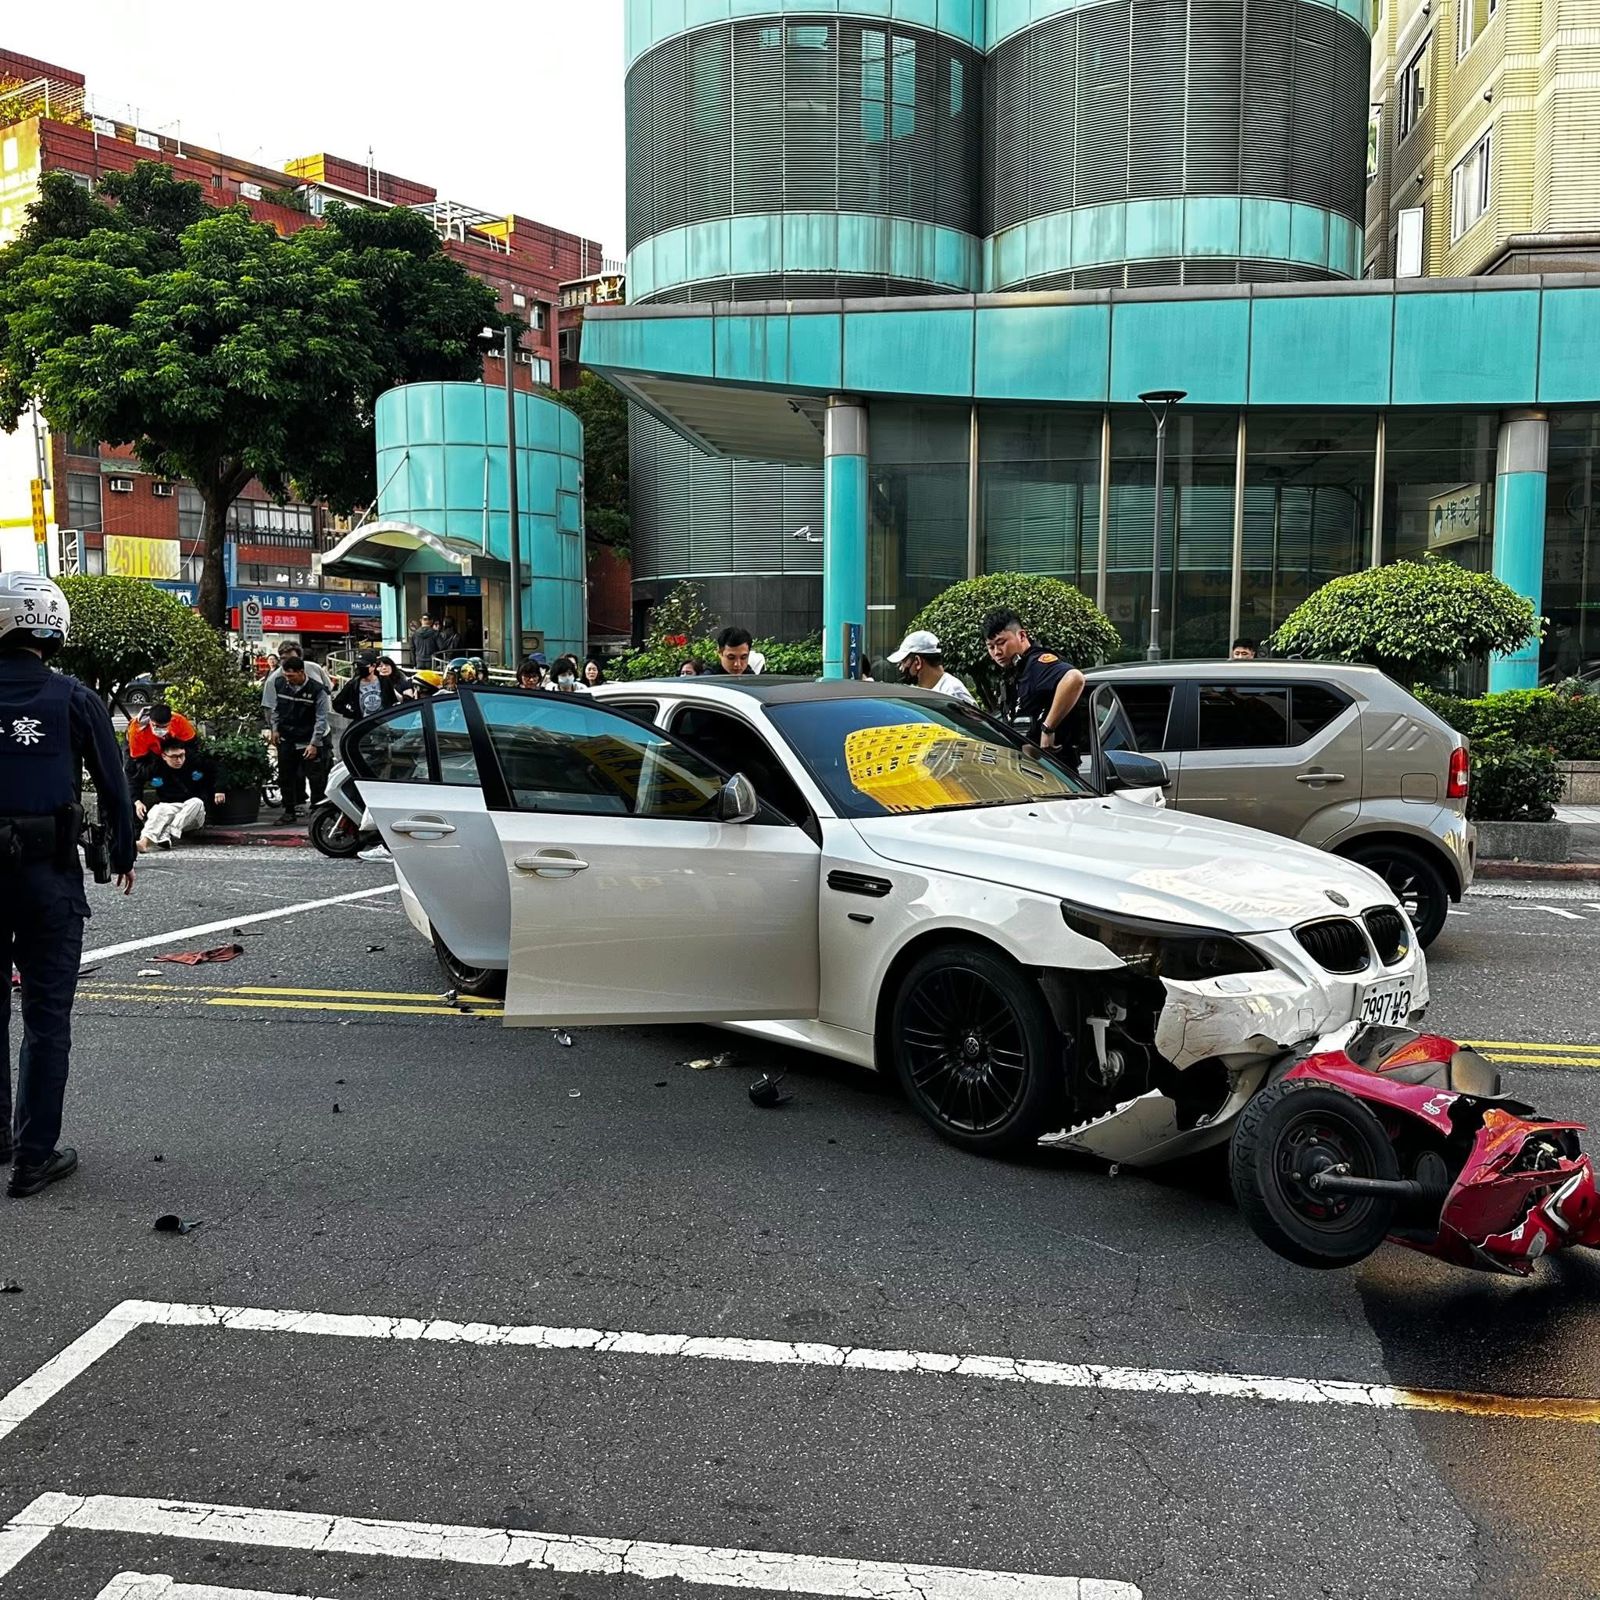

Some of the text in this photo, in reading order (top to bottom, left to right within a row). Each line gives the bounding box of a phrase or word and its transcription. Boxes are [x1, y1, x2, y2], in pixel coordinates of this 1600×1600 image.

[23, 598, 59, 613] 警察
[14, 613, 64, 629] POLICE
[0, 716, 47, 746] 察
